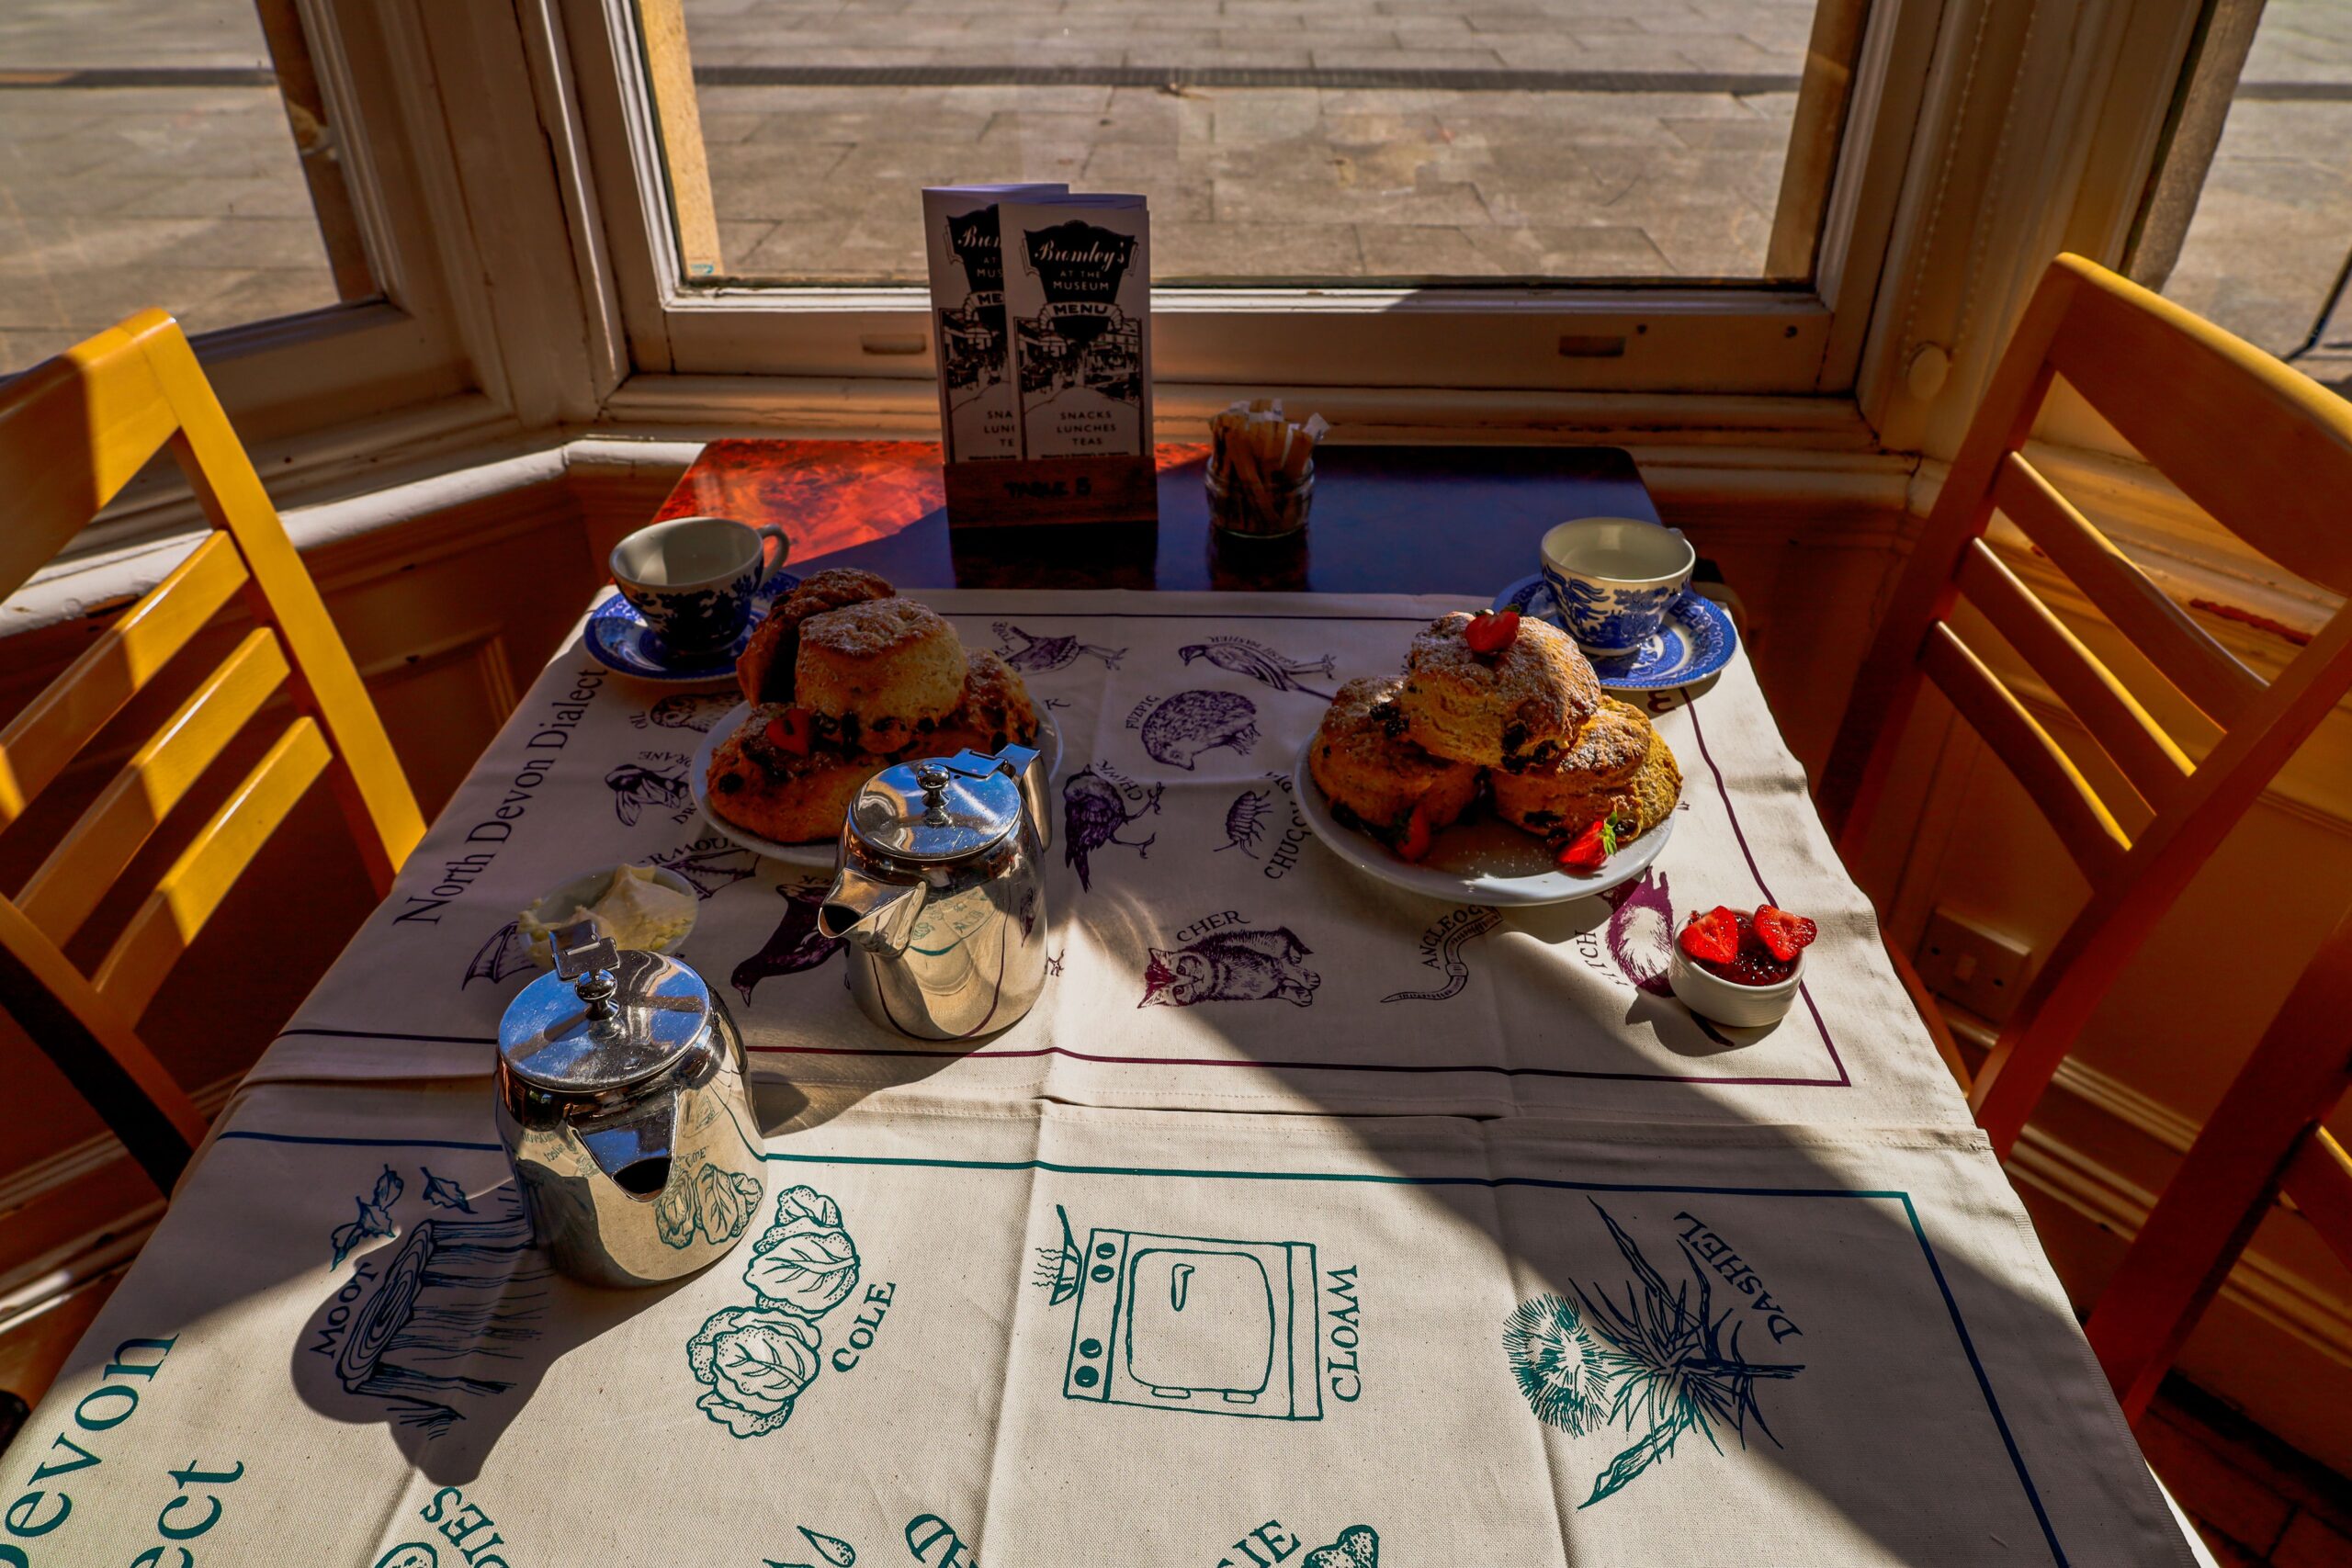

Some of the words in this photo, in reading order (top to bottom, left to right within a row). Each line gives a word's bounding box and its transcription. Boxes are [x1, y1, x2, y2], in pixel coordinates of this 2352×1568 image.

[1035, 240, 1125, 273] Bromley's
[1053, 280, 1110, 291] MUSEUM
[1060, 270, 1074, 278] AT
[1080, 270, 1102, 279] THE
[1053, 304, 1109, 316] MENU
[1057, 423, 1117, 434] LUNCHES
[1060, 411, 1113, 421] SNACKS
[1072, 436, 1103, 446] TEAS
[1126, 695, 1160, 732] FUZPIG
[392, 852, 497, 926] North
[465, 759, 557, 844] Devon
[526, 669, 608, 750] Dialect
[1176, 910, 1250, 942] CHER
[1673, 1211, 1804, 1344] DASHEL
[310, 1261, 378, 1359] MOOT
[831, 1282, 896, 1373] COLE
[1328, 1265, 1362, 1402] CLOAM
